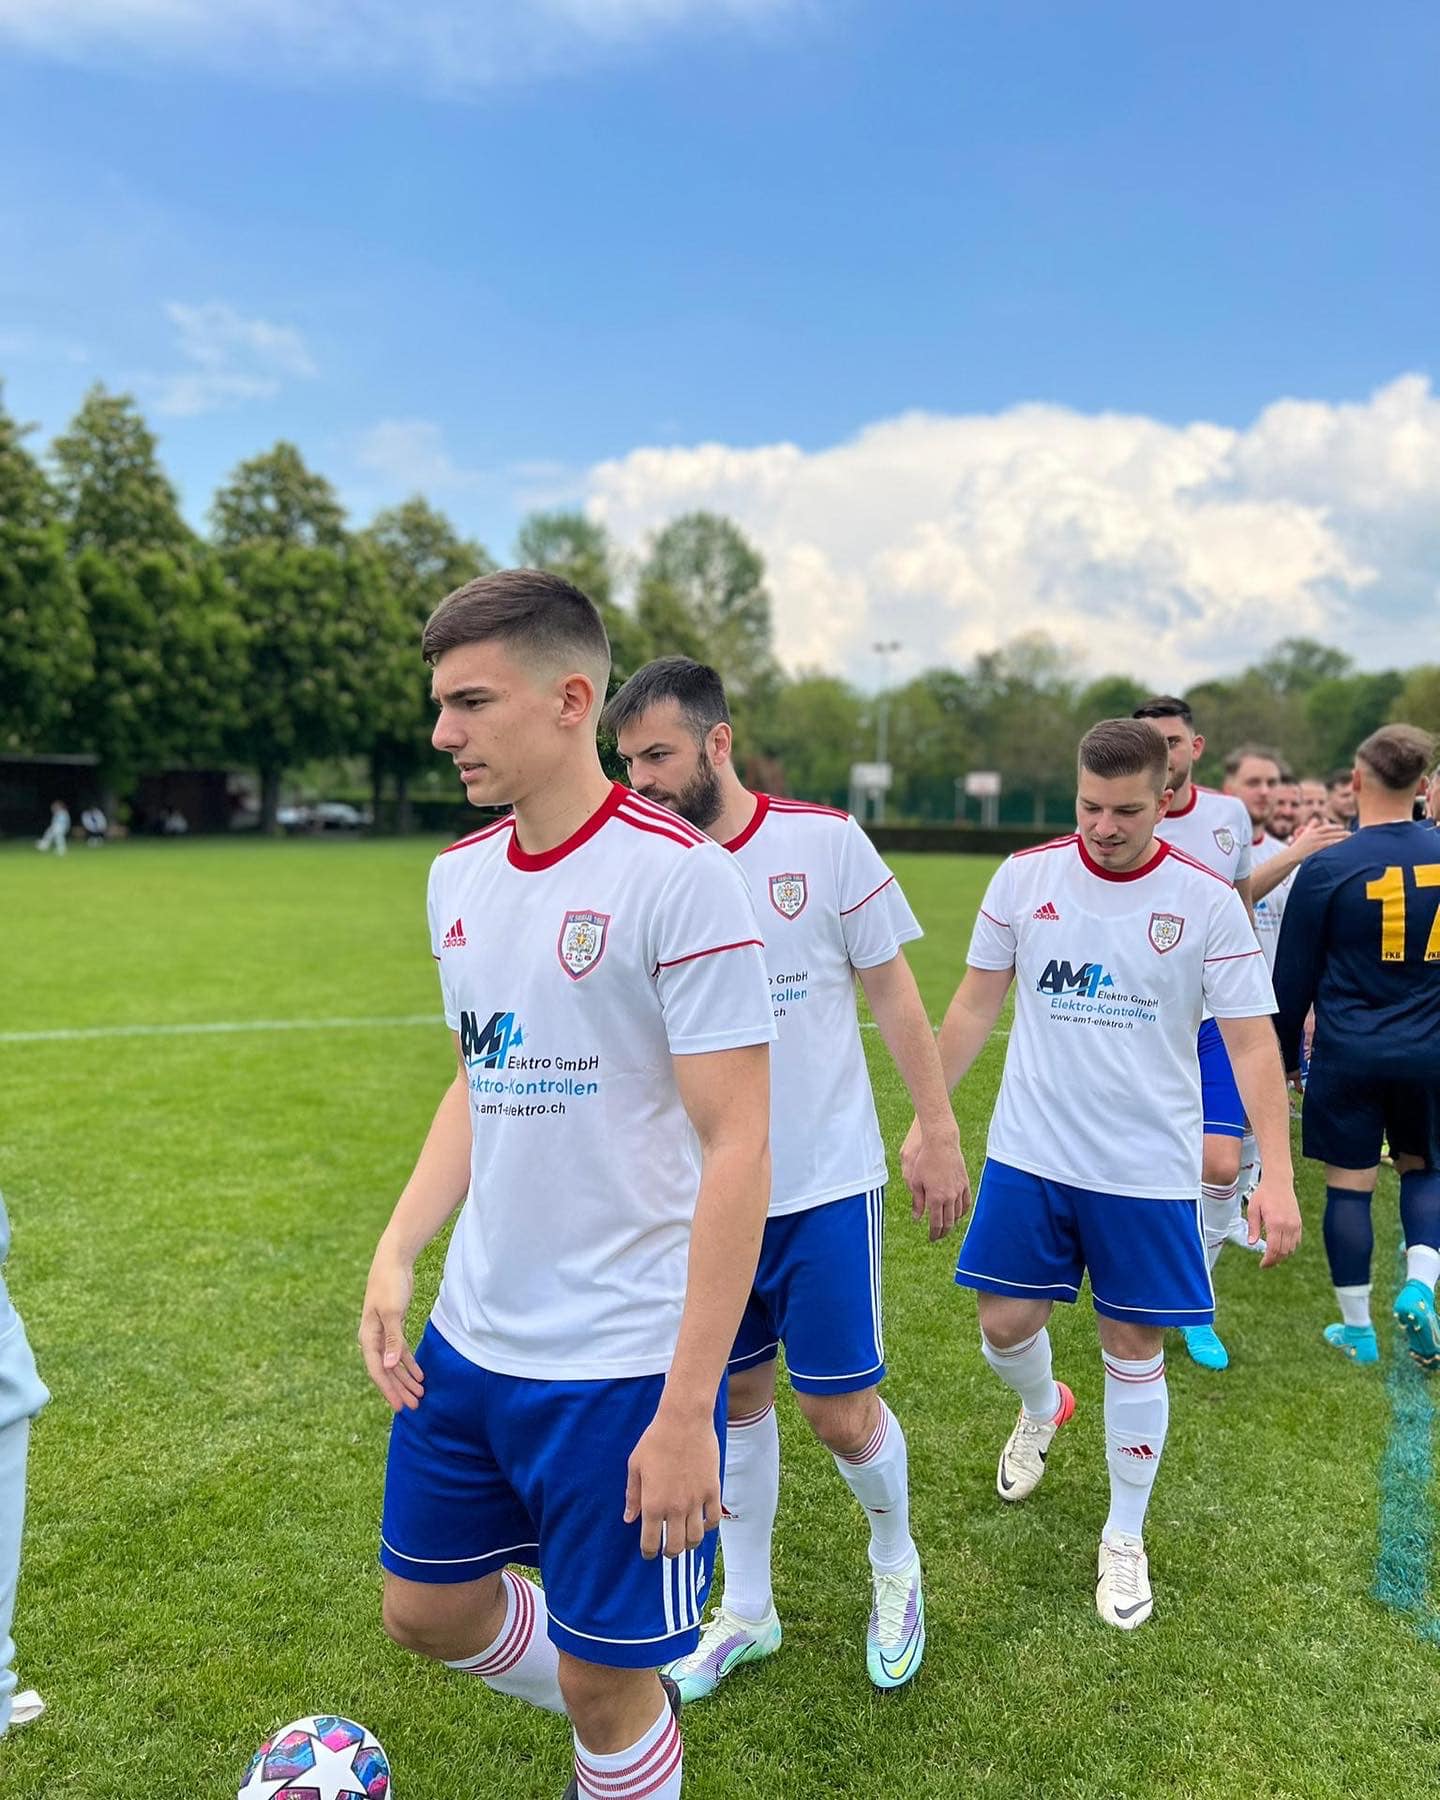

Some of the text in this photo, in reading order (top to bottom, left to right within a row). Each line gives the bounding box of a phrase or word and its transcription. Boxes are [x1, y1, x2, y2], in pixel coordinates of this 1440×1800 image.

[1033, 913, 1060, 921] adidas
[776, 971, 808, 984] GmbH
[1037, 960, 1103, 998] AM1
[771, 988, 807, 1003] rollen
[1097, 991, 1159, 1008] Elektro GmbH
[1051, 998, 1157, 1022] Elektro-Kontrollen
[555, 1055, 599, 1072] GmbH
